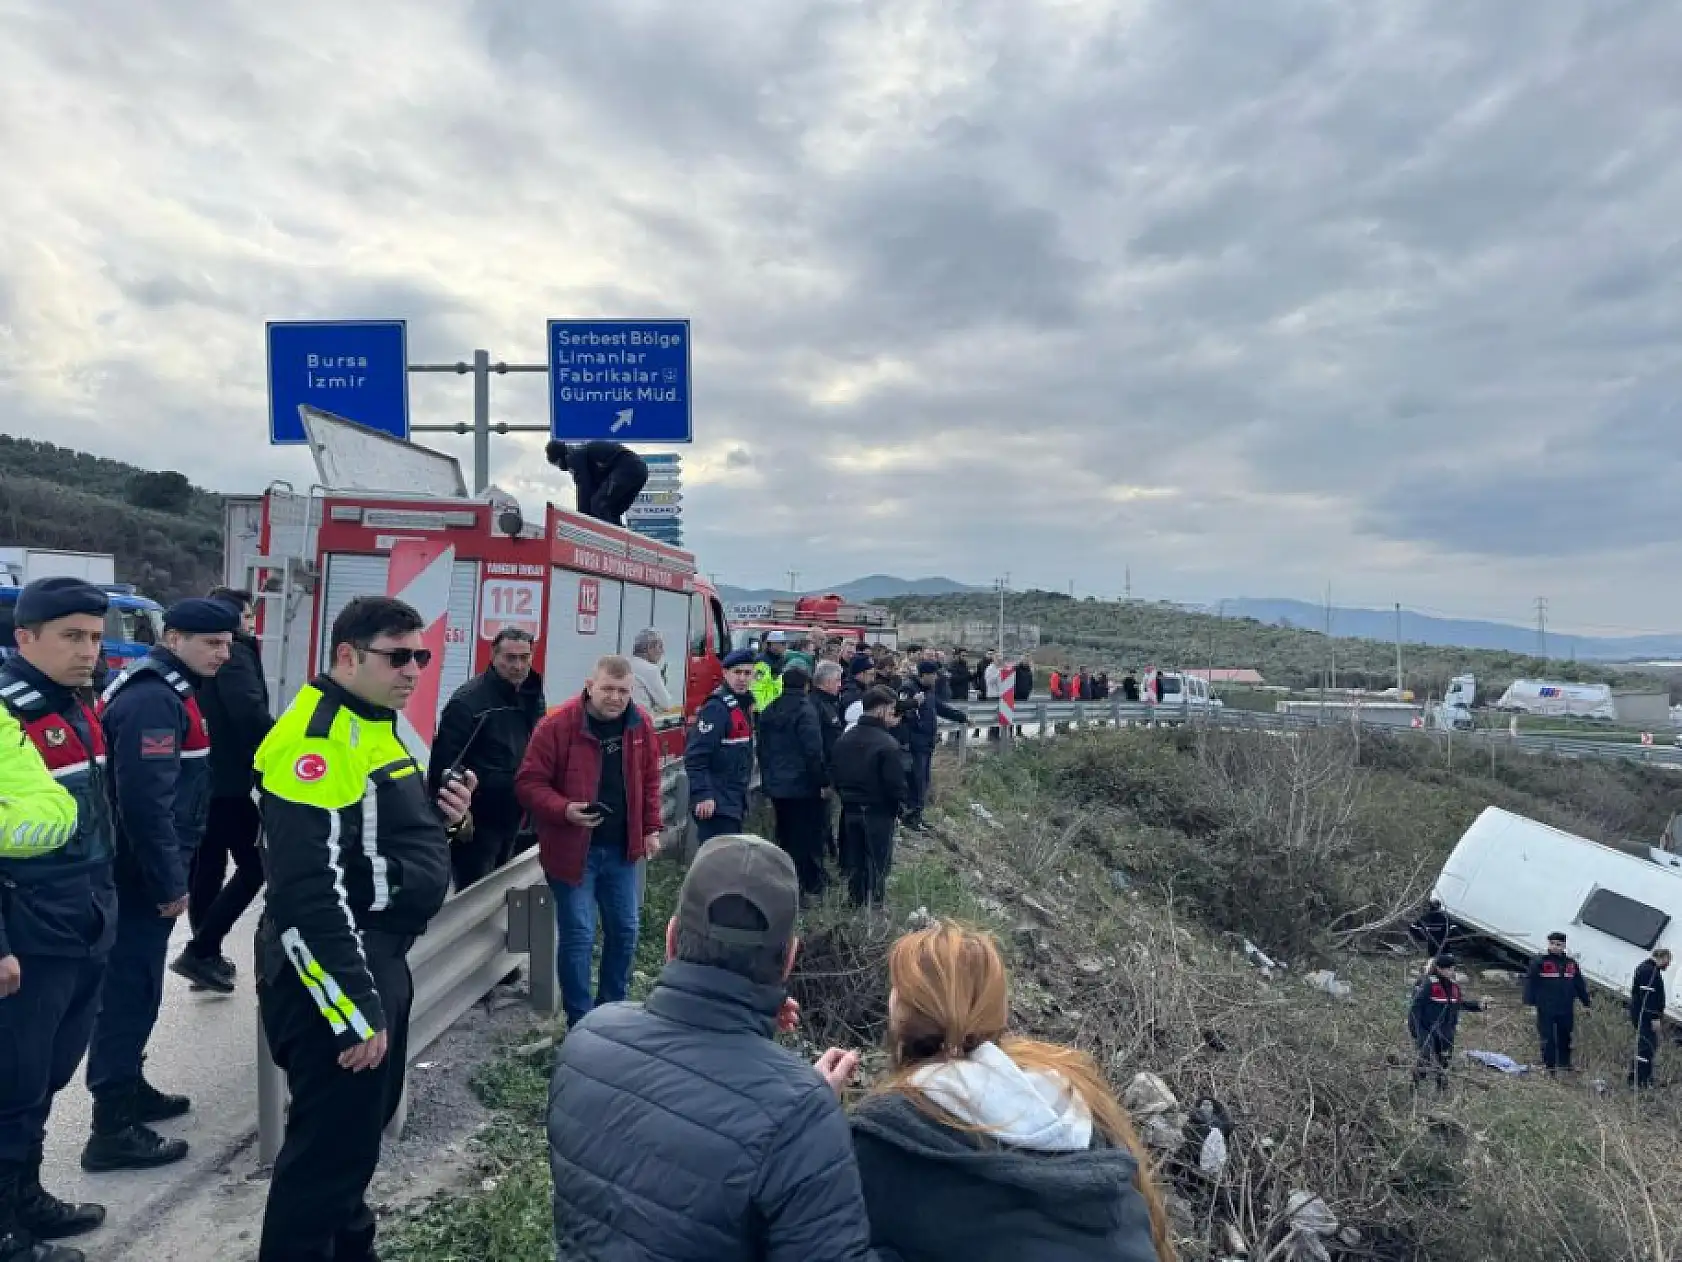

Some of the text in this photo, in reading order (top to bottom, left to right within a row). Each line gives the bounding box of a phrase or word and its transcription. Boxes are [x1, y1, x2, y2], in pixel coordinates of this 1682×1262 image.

[558, 330, 681, 349] Serbest Bölge
[306, 353, 368, 369] Bursa
[558, 349, 647, 365] Limanlar
[307, 370, 367, 389] İzmir
[559, 367, 659, 383] Fabrikalar
[560, 386, 633, 402] Gümrük
[490, 586, 533, 616] 112
